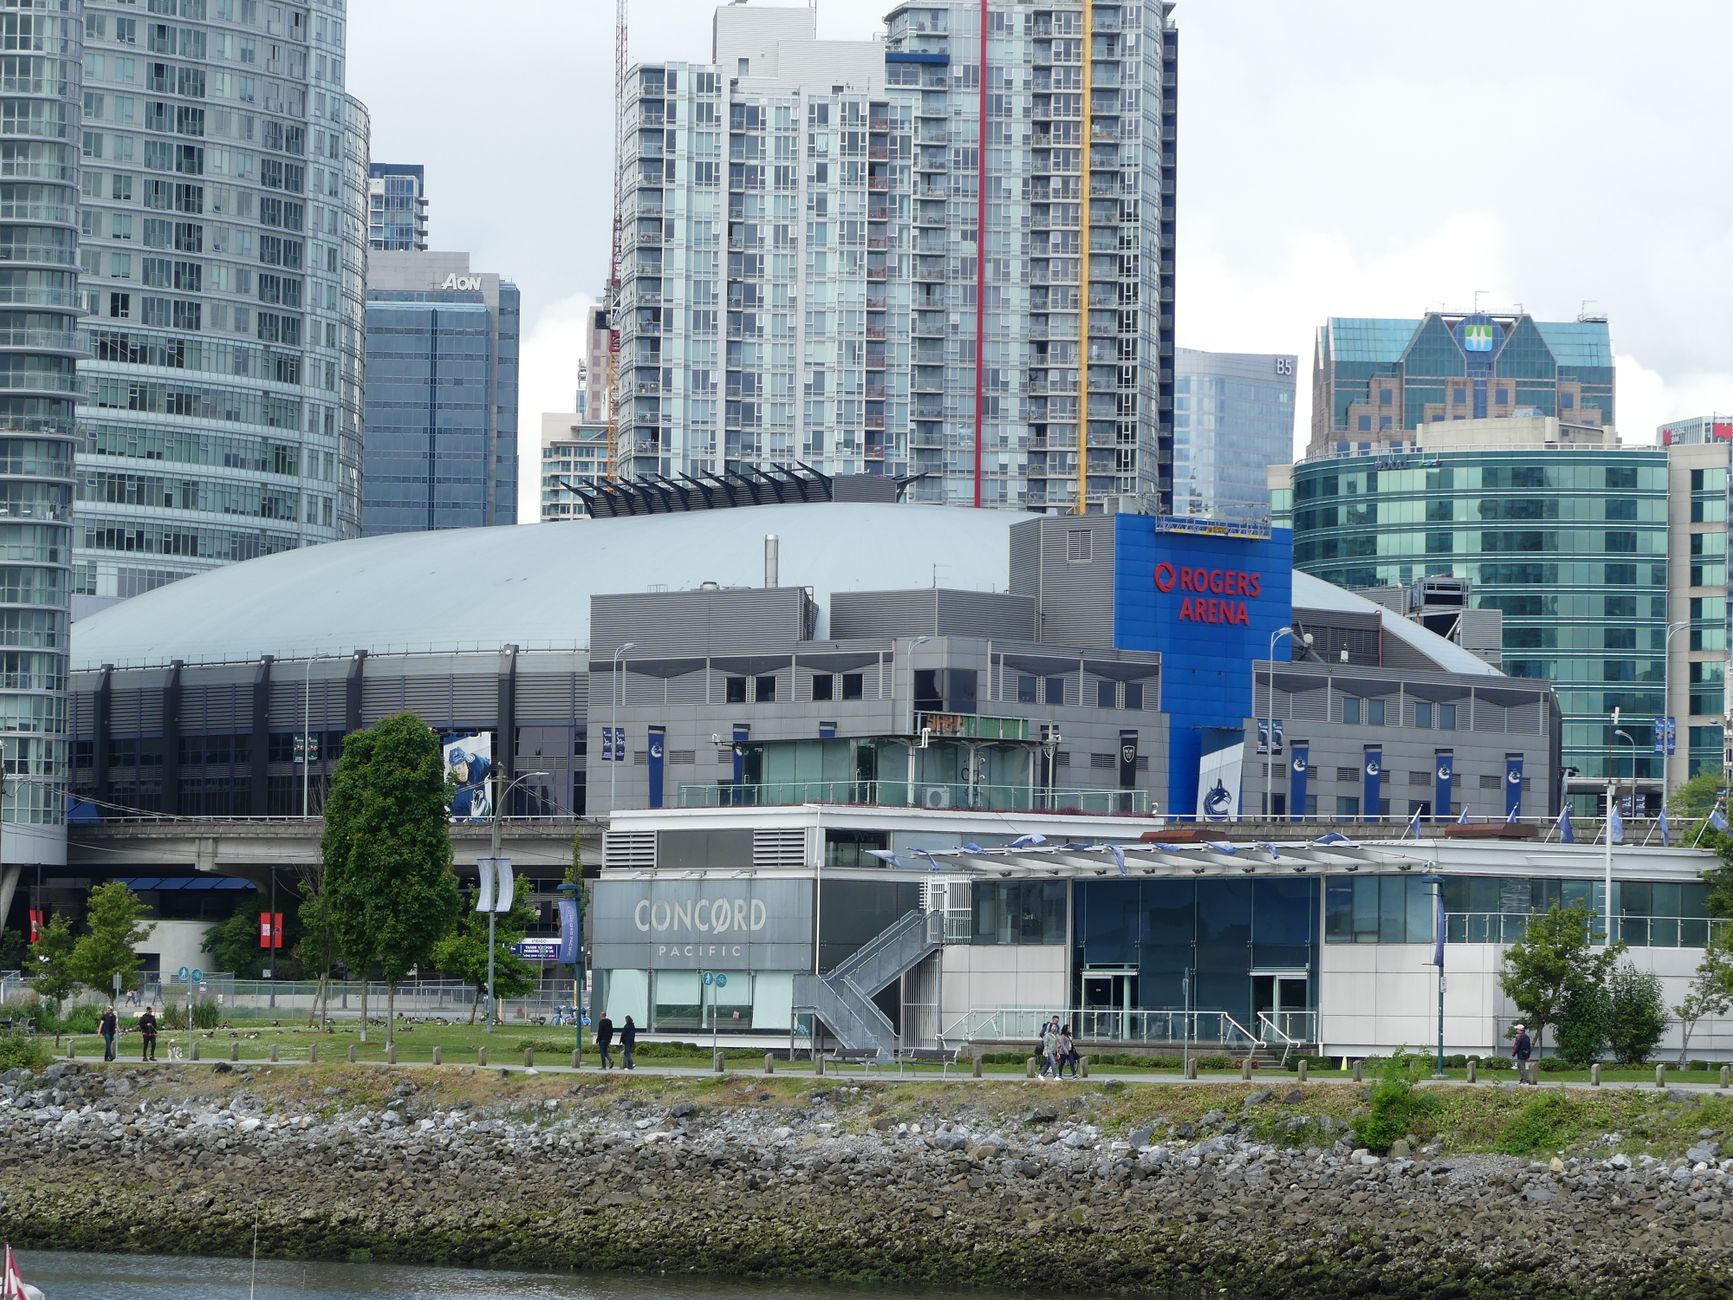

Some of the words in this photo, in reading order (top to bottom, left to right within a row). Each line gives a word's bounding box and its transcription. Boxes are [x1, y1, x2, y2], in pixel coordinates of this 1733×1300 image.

[441, 272, 481, 290] AON
[1277, 358, 1292, 375] B5
[1180, 566, 1262, 597] ROGERS
[1178, 597, 1250, 626] ARENA
[658, 945, 741, 957] PACIFIC
